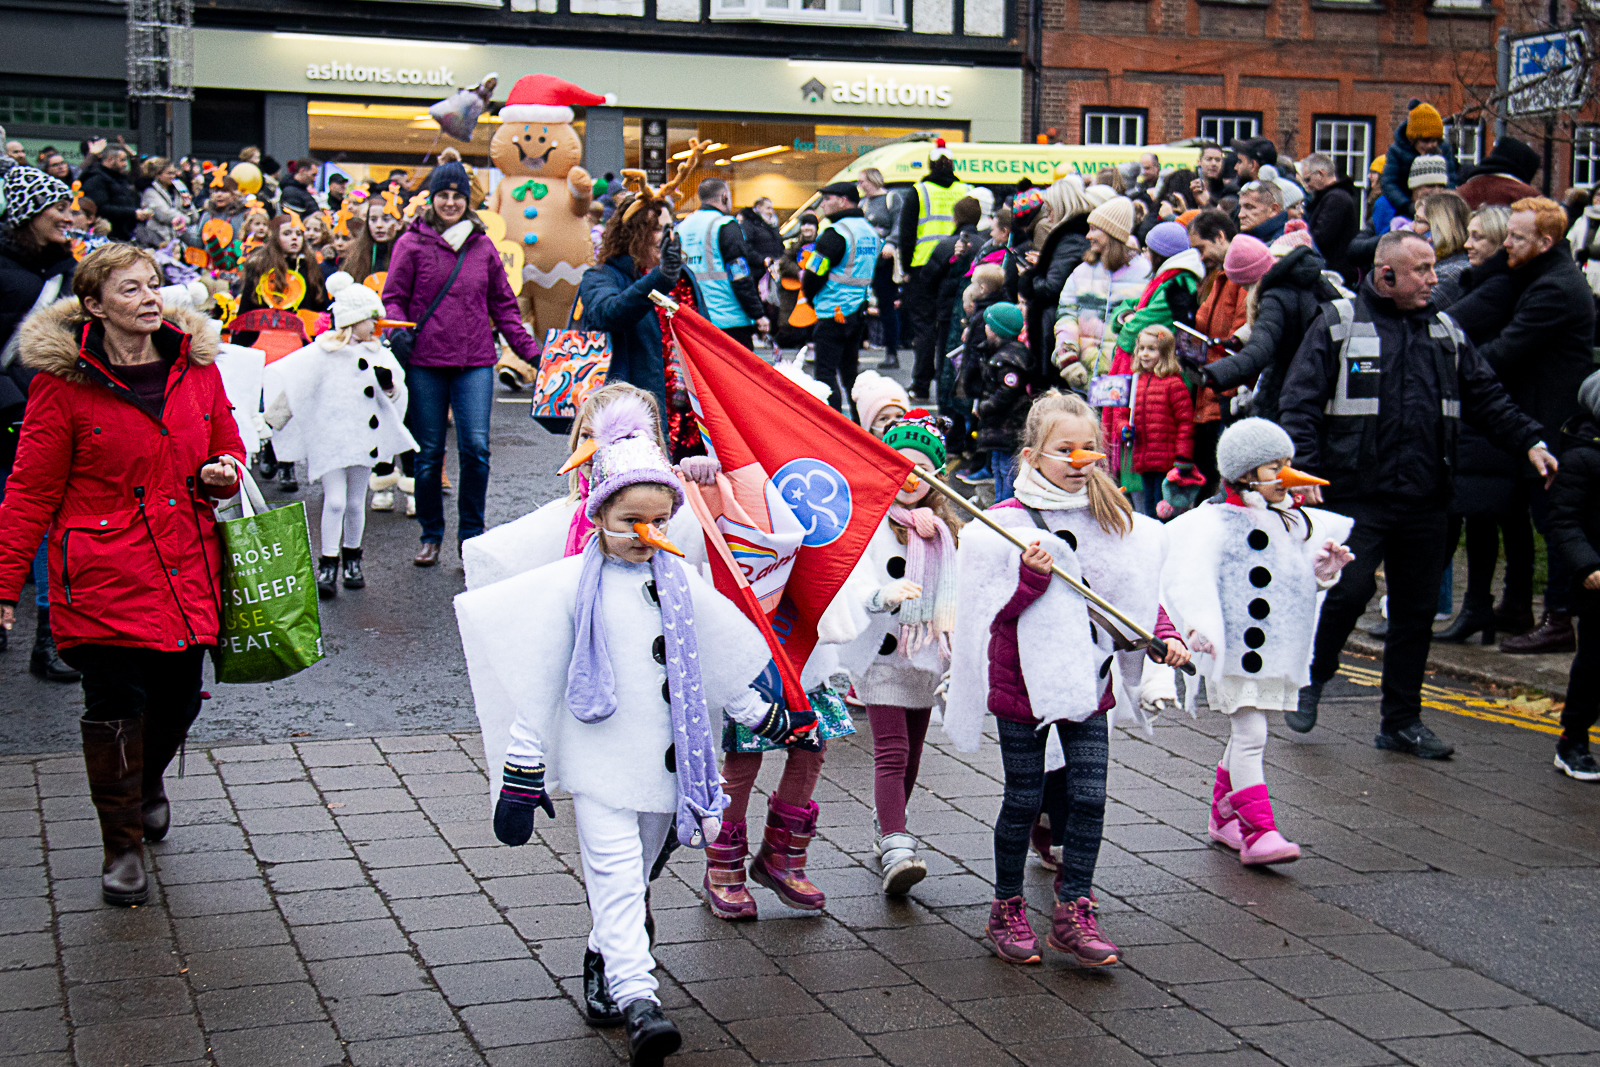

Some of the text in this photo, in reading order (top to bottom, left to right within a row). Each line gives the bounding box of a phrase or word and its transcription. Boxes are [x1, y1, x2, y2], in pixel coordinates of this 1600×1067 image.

[305, 60, 455, 86] ashtons.co.uk
[831, 74, 953, 107] ashtons
[951, 158, 1062, 175] MERGENCY
[231, 542, 284, 567] ROSE
[232, 575, 302, 607] SLEEP.
